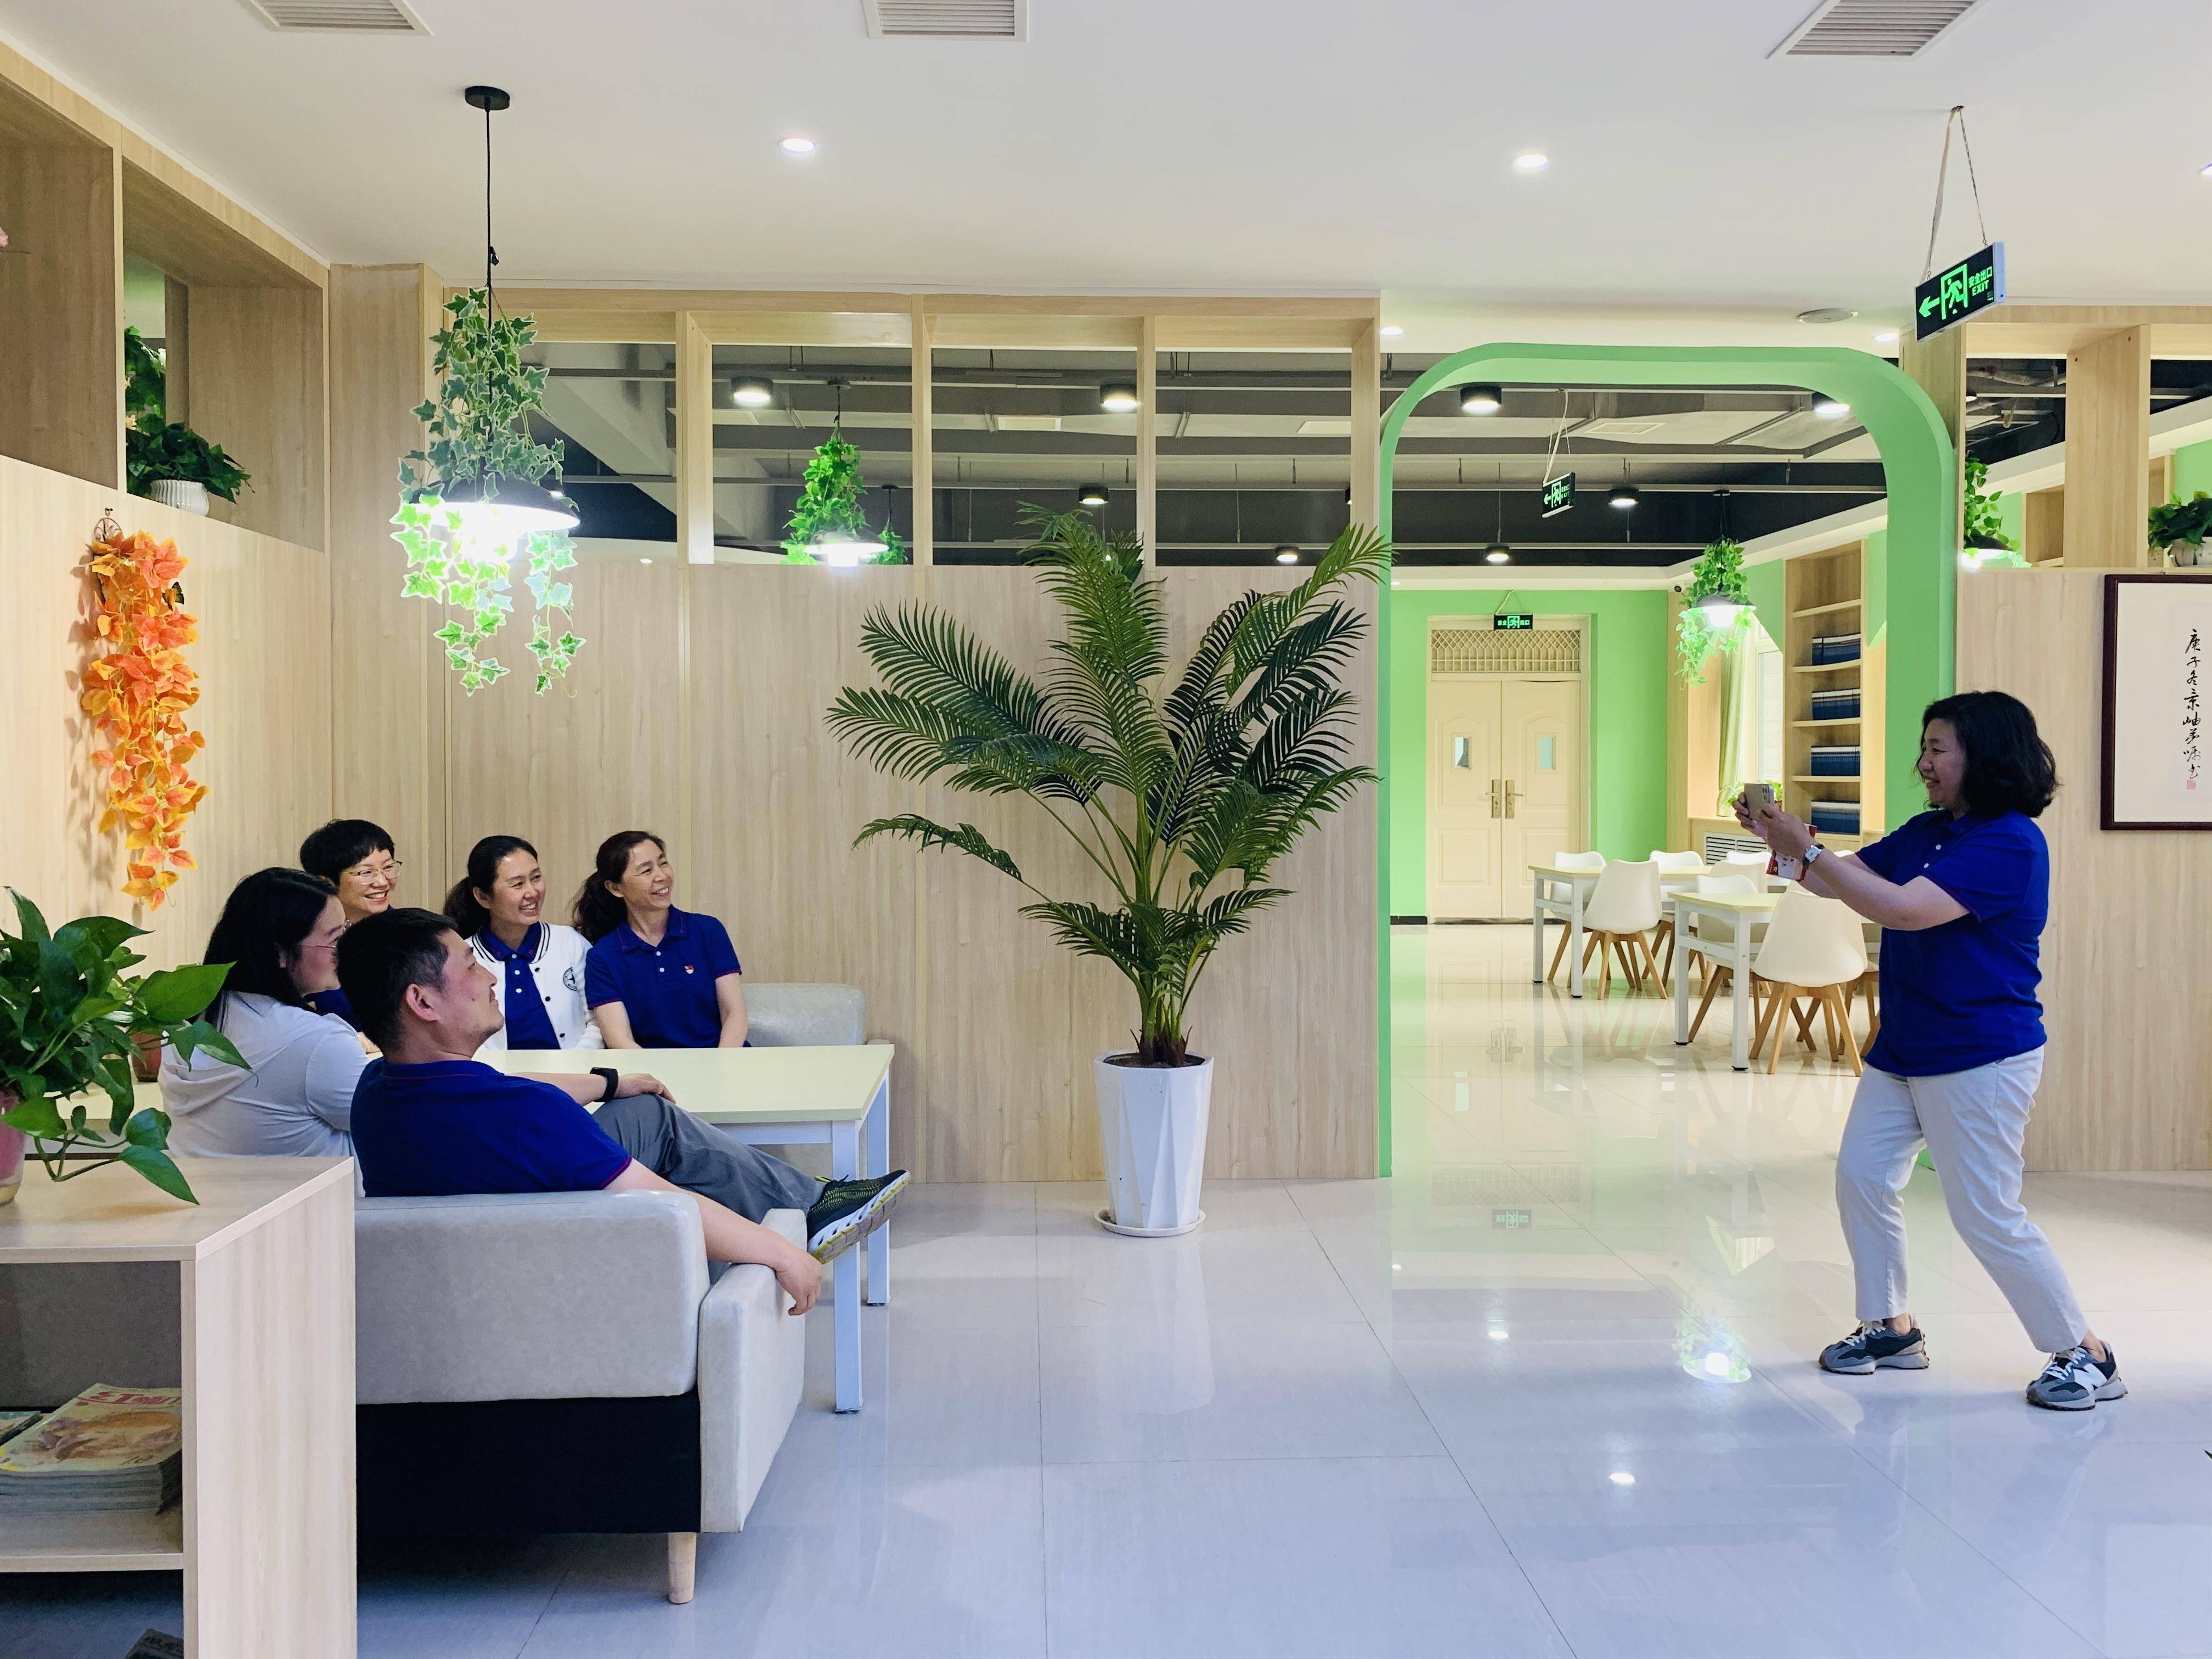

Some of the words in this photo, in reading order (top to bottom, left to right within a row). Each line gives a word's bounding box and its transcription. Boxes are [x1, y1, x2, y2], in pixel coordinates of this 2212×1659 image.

[1968, 266, 1993, 288] 安全出口
[1972, 279, 1989, 296] EXIT
